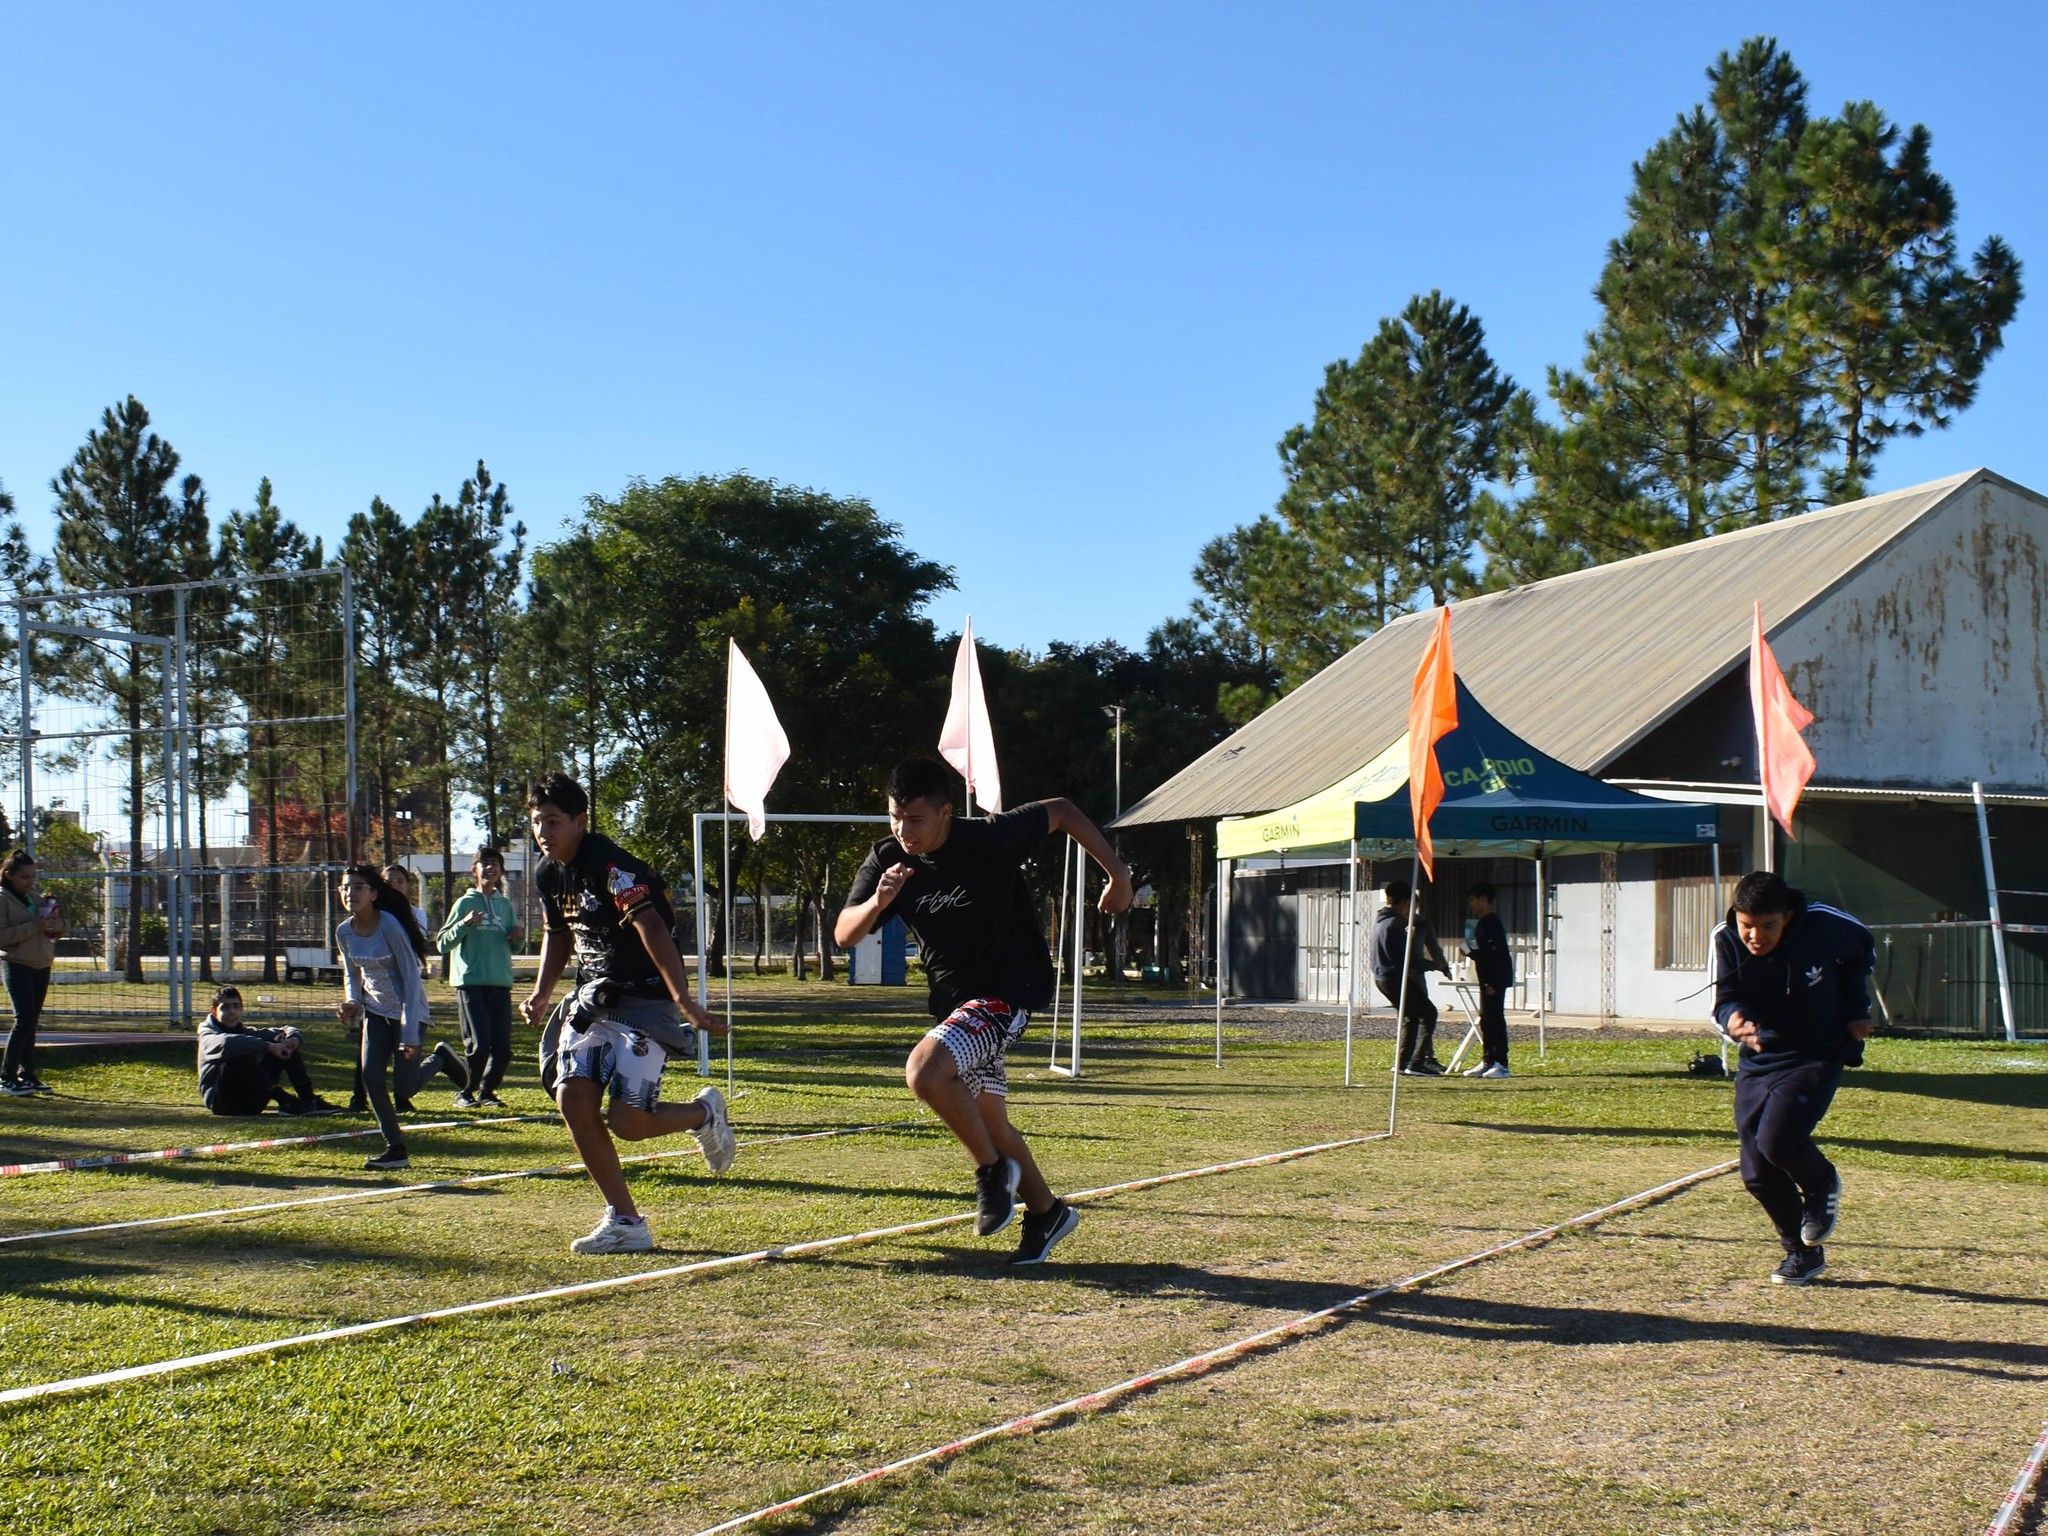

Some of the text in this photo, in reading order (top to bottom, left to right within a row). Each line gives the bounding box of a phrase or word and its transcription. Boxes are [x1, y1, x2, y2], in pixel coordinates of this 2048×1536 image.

[1262, 824, 1300, 842] GARMIN
[1490, 815, 1588, 833] GARMIN
[915, 885, 973, 914] Flight
